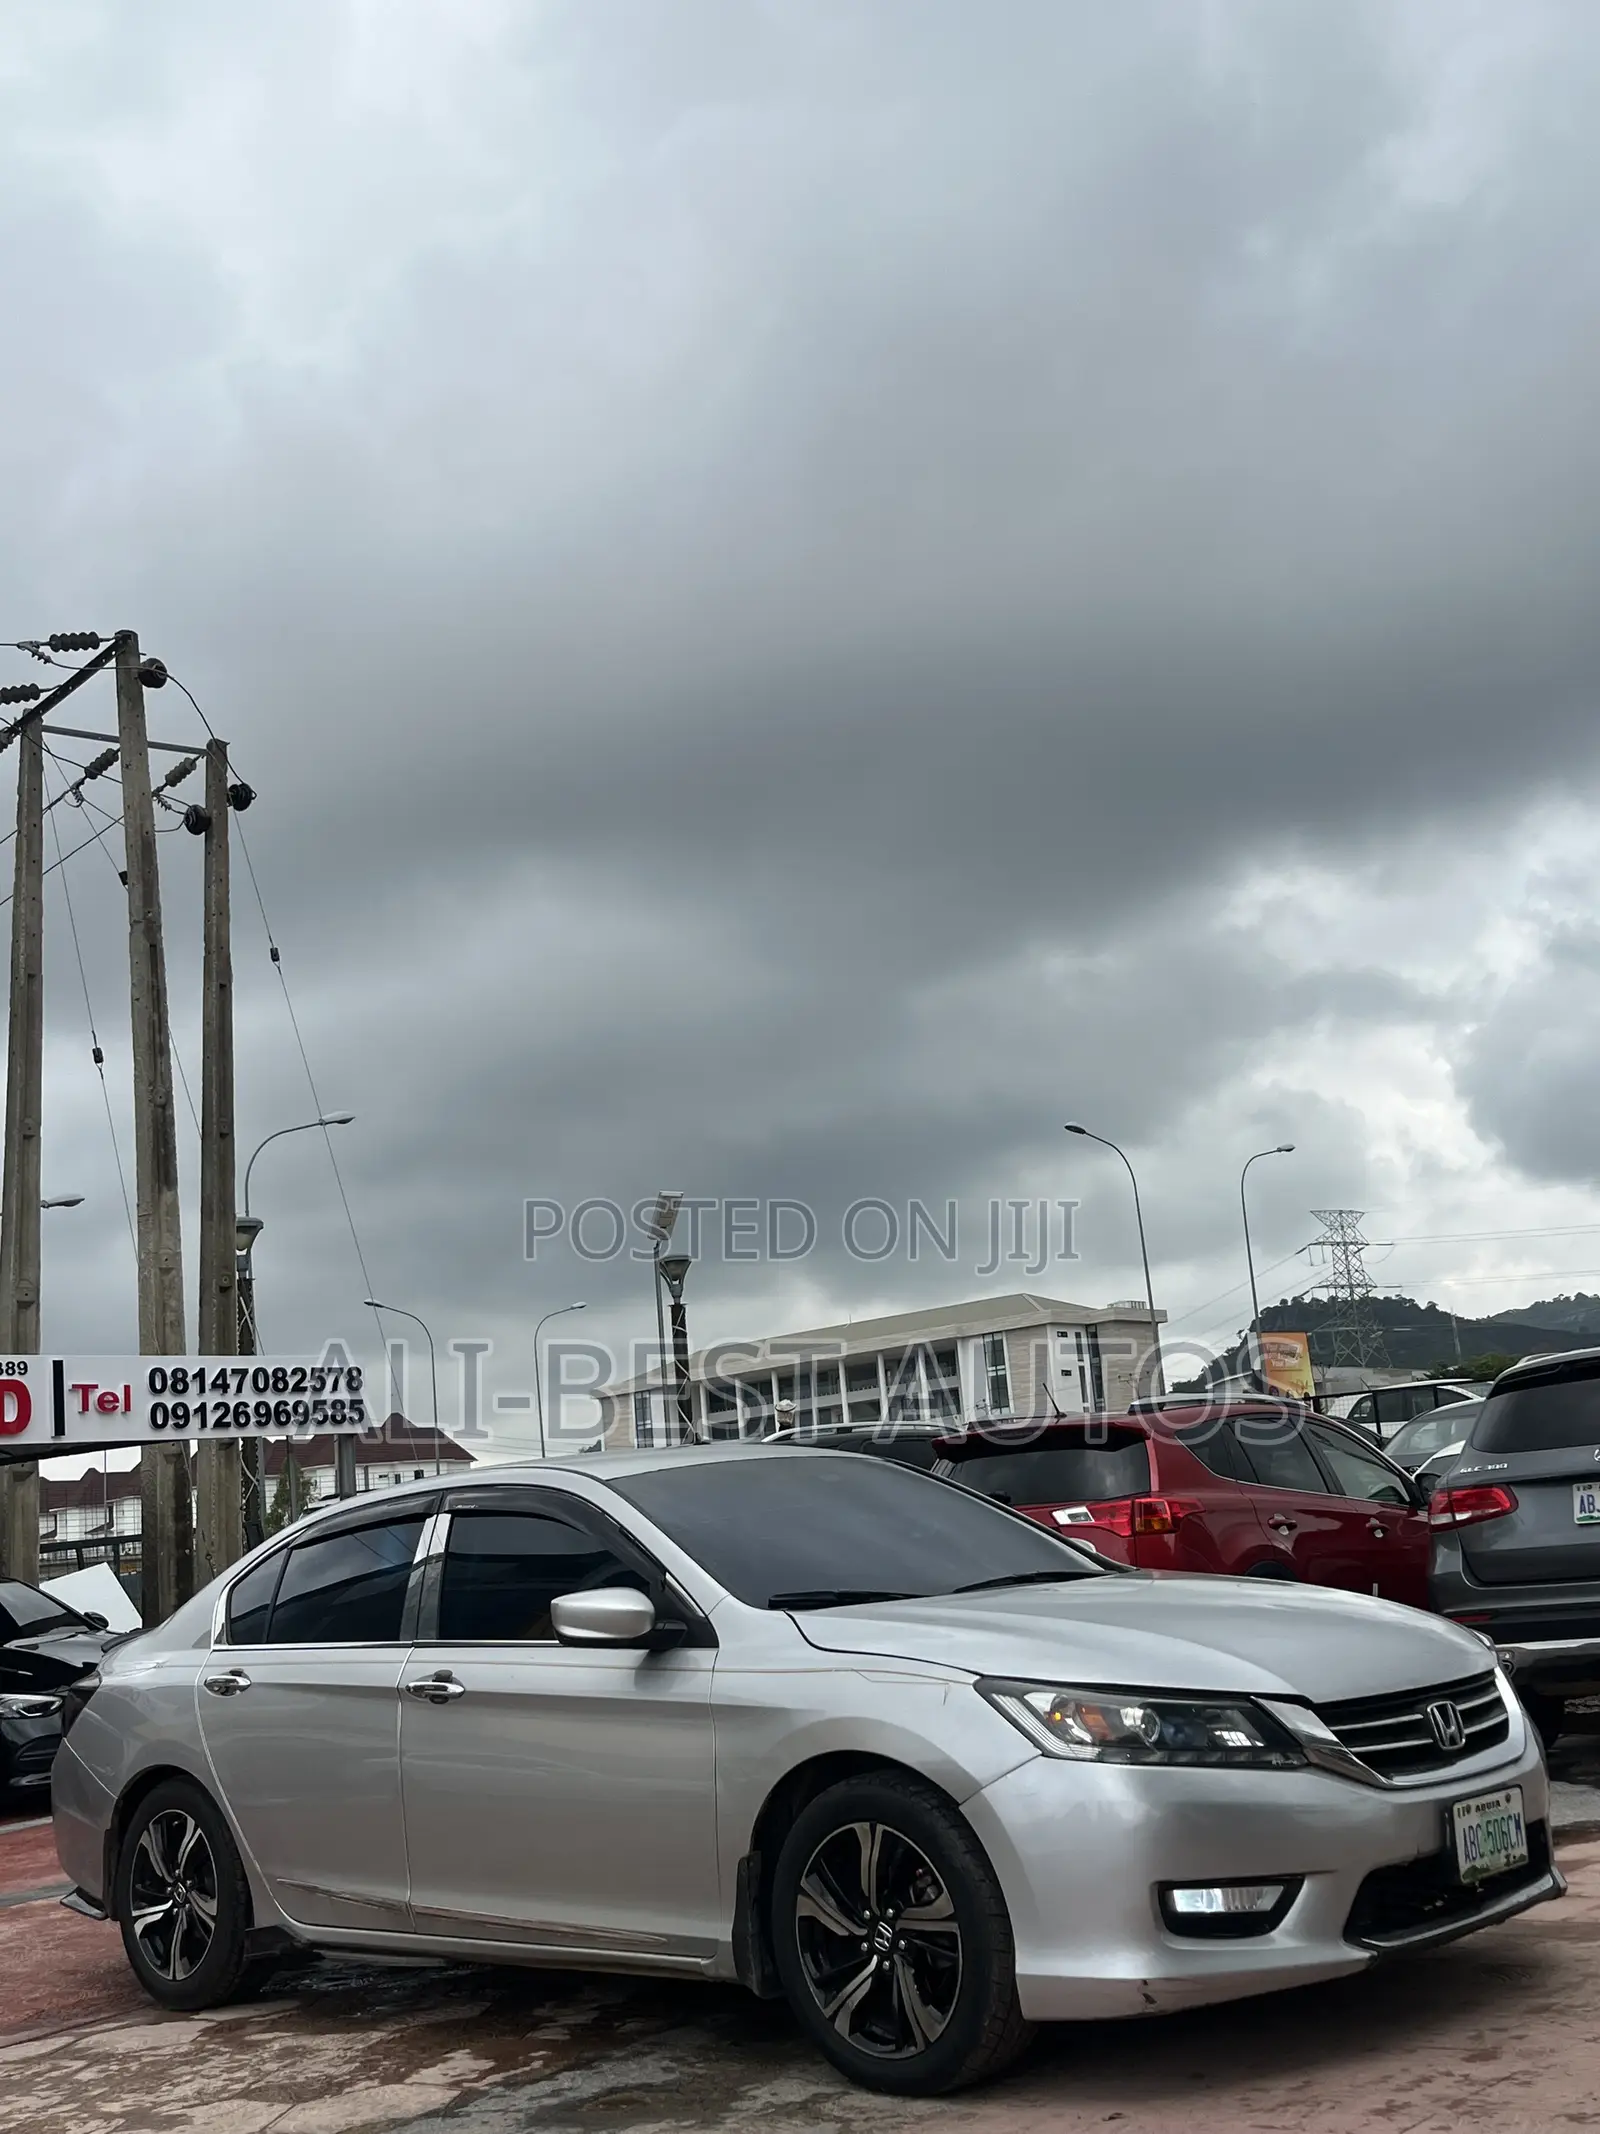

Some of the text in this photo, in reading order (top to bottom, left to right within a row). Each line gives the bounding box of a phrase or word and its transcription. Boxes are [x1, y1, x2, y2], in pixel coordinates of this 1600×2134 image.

[148, 1366, 363, 1395] 08147082578
[71, 1384, 131, 1413] Tel
[150, 1398, 365, 1429] 09126969585
[1579, 1494, 1600, 1514] AB
